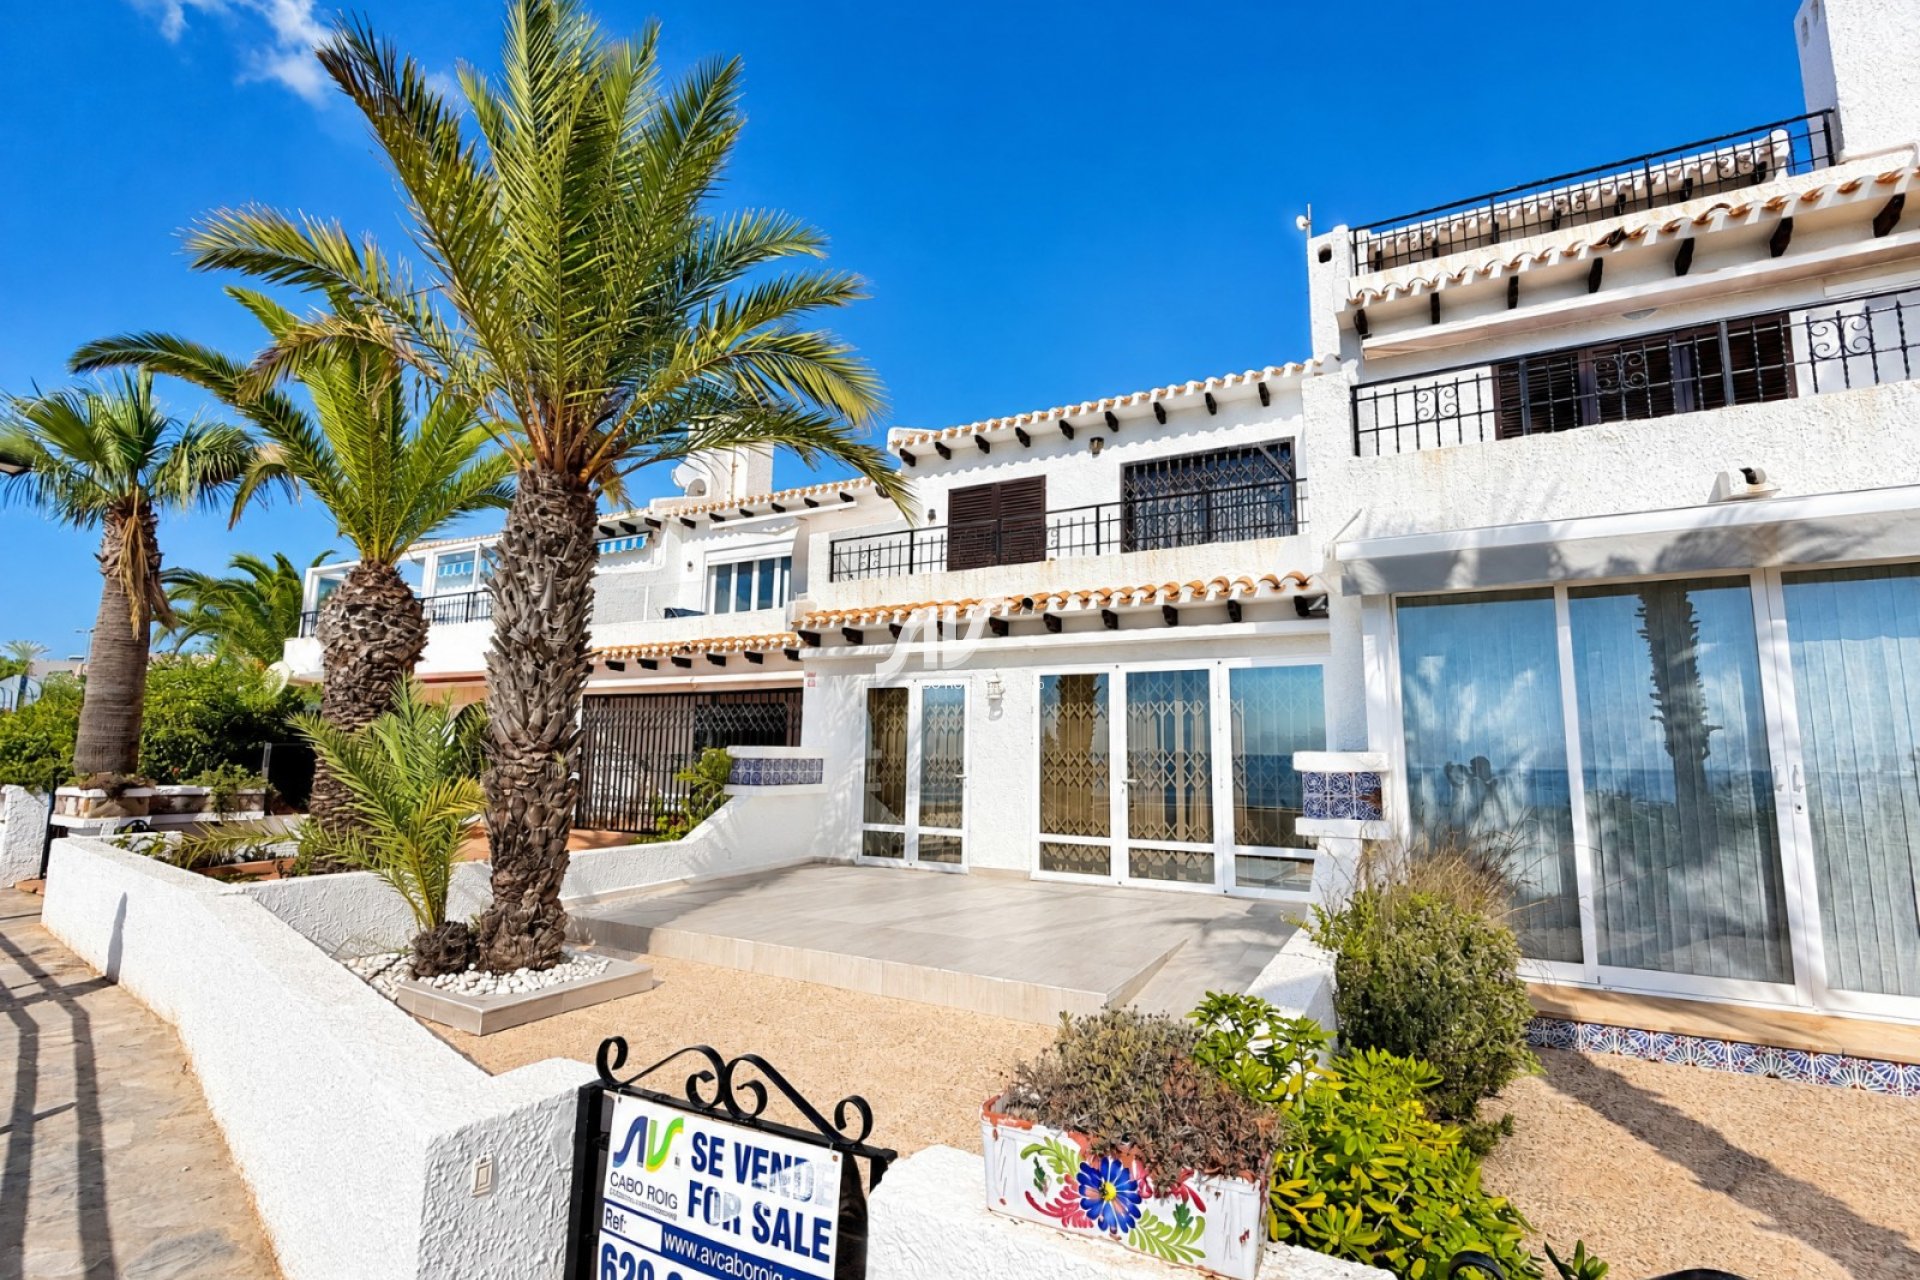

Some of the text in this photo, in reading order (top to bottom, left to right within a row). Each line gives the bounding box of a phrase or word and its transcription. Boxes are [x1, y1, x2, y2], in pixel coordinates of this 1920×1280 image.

[610, 1171, 643, 1196] CABO
[647, 1185, 678, 1210] ROIG
[691, 1131, 725, 1178] SE
[734, 1142, 836, 1208] VENDE
[605, 1207, 627, 1234] Ref:
[688, 1179, 742, 1235] FOR
[751, 1200, 832, 1264] SALE
